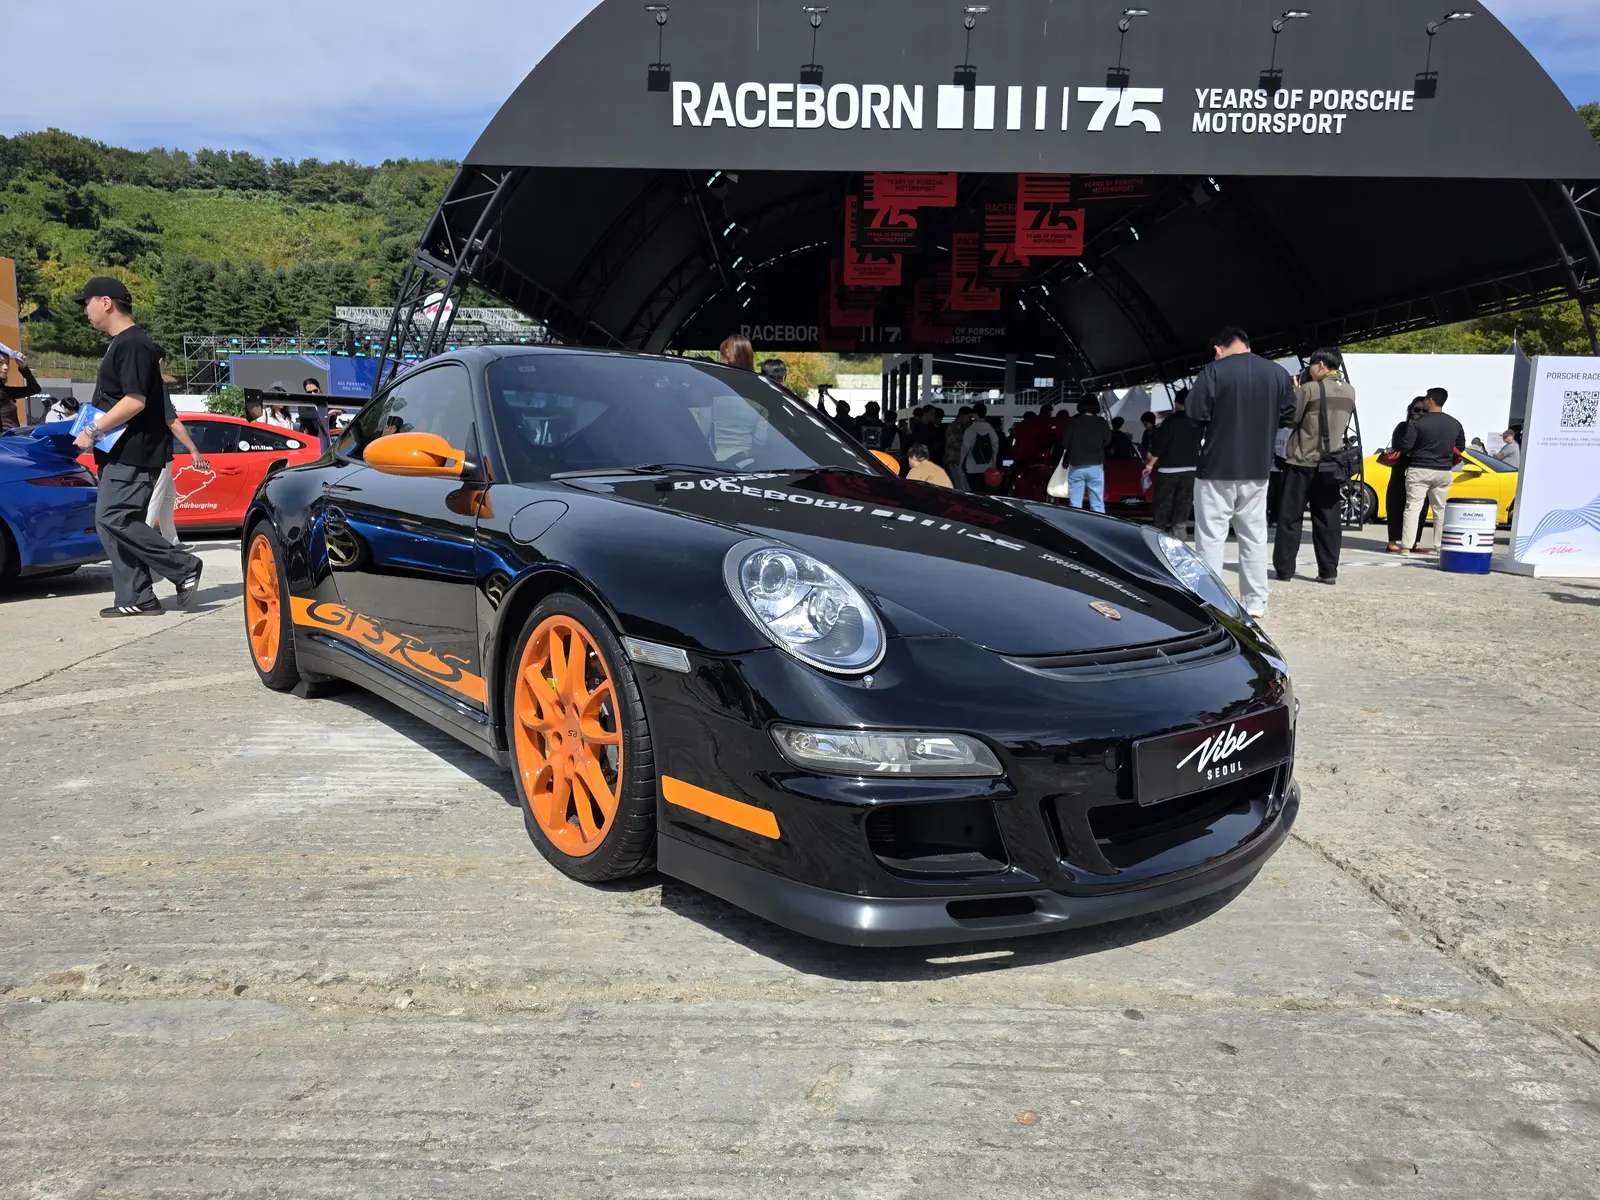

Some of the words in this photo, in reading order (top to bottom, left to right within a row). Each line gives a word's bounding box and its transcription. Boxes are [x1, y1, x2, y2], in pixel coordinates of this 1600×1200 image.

[672, 81, 924, 130] RACEBORN
[1077, 87, 1164, 133] 75
[1195, 88, 1268, 110] YEARS
[1274, 88, 1304, 110] OF
[1309, 89, 1415, 111] PORSCHE
[1192, 112, 1347, 135] MOTORSPORT
[1023, 202, 1077, 230] 75
[1546, 372, 1581, 380] PORSCHE
[1467, 534, 1473, 545] 1
[306, 600, 385, 645] GT3
[1176, 723, 1265, 773] Vibe
[1207, 760, 1243, 781] SEOUL
